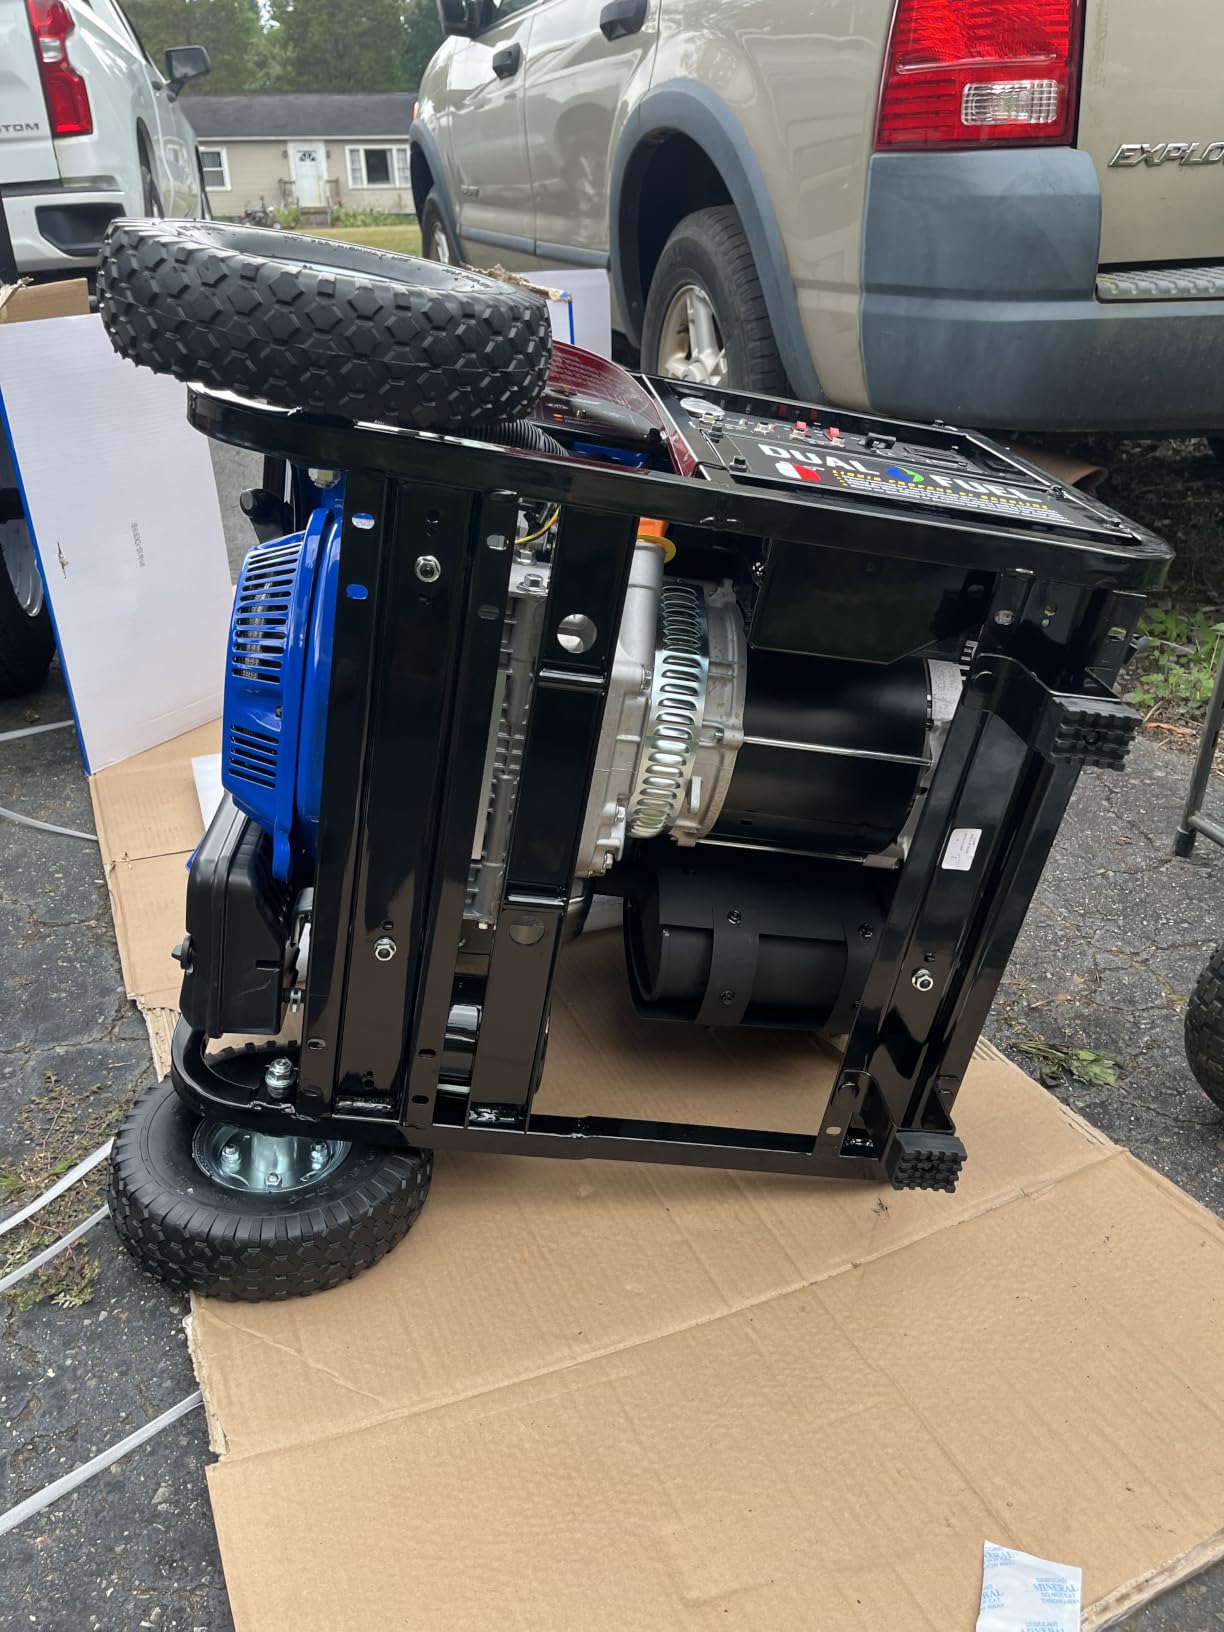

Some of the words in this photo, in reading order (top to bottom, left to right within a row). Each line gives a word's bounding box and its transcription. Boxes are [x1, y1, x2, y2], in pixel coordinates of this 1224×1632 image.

[0, 122, 40, 132] TOM
[1107, 141, 1224, 167] EXPLO
[757, 443, 881, 475] DUAL
[929, 474, 1043, 503] FUEL
[1032, 1583, 1079, 1593] MINERAL
